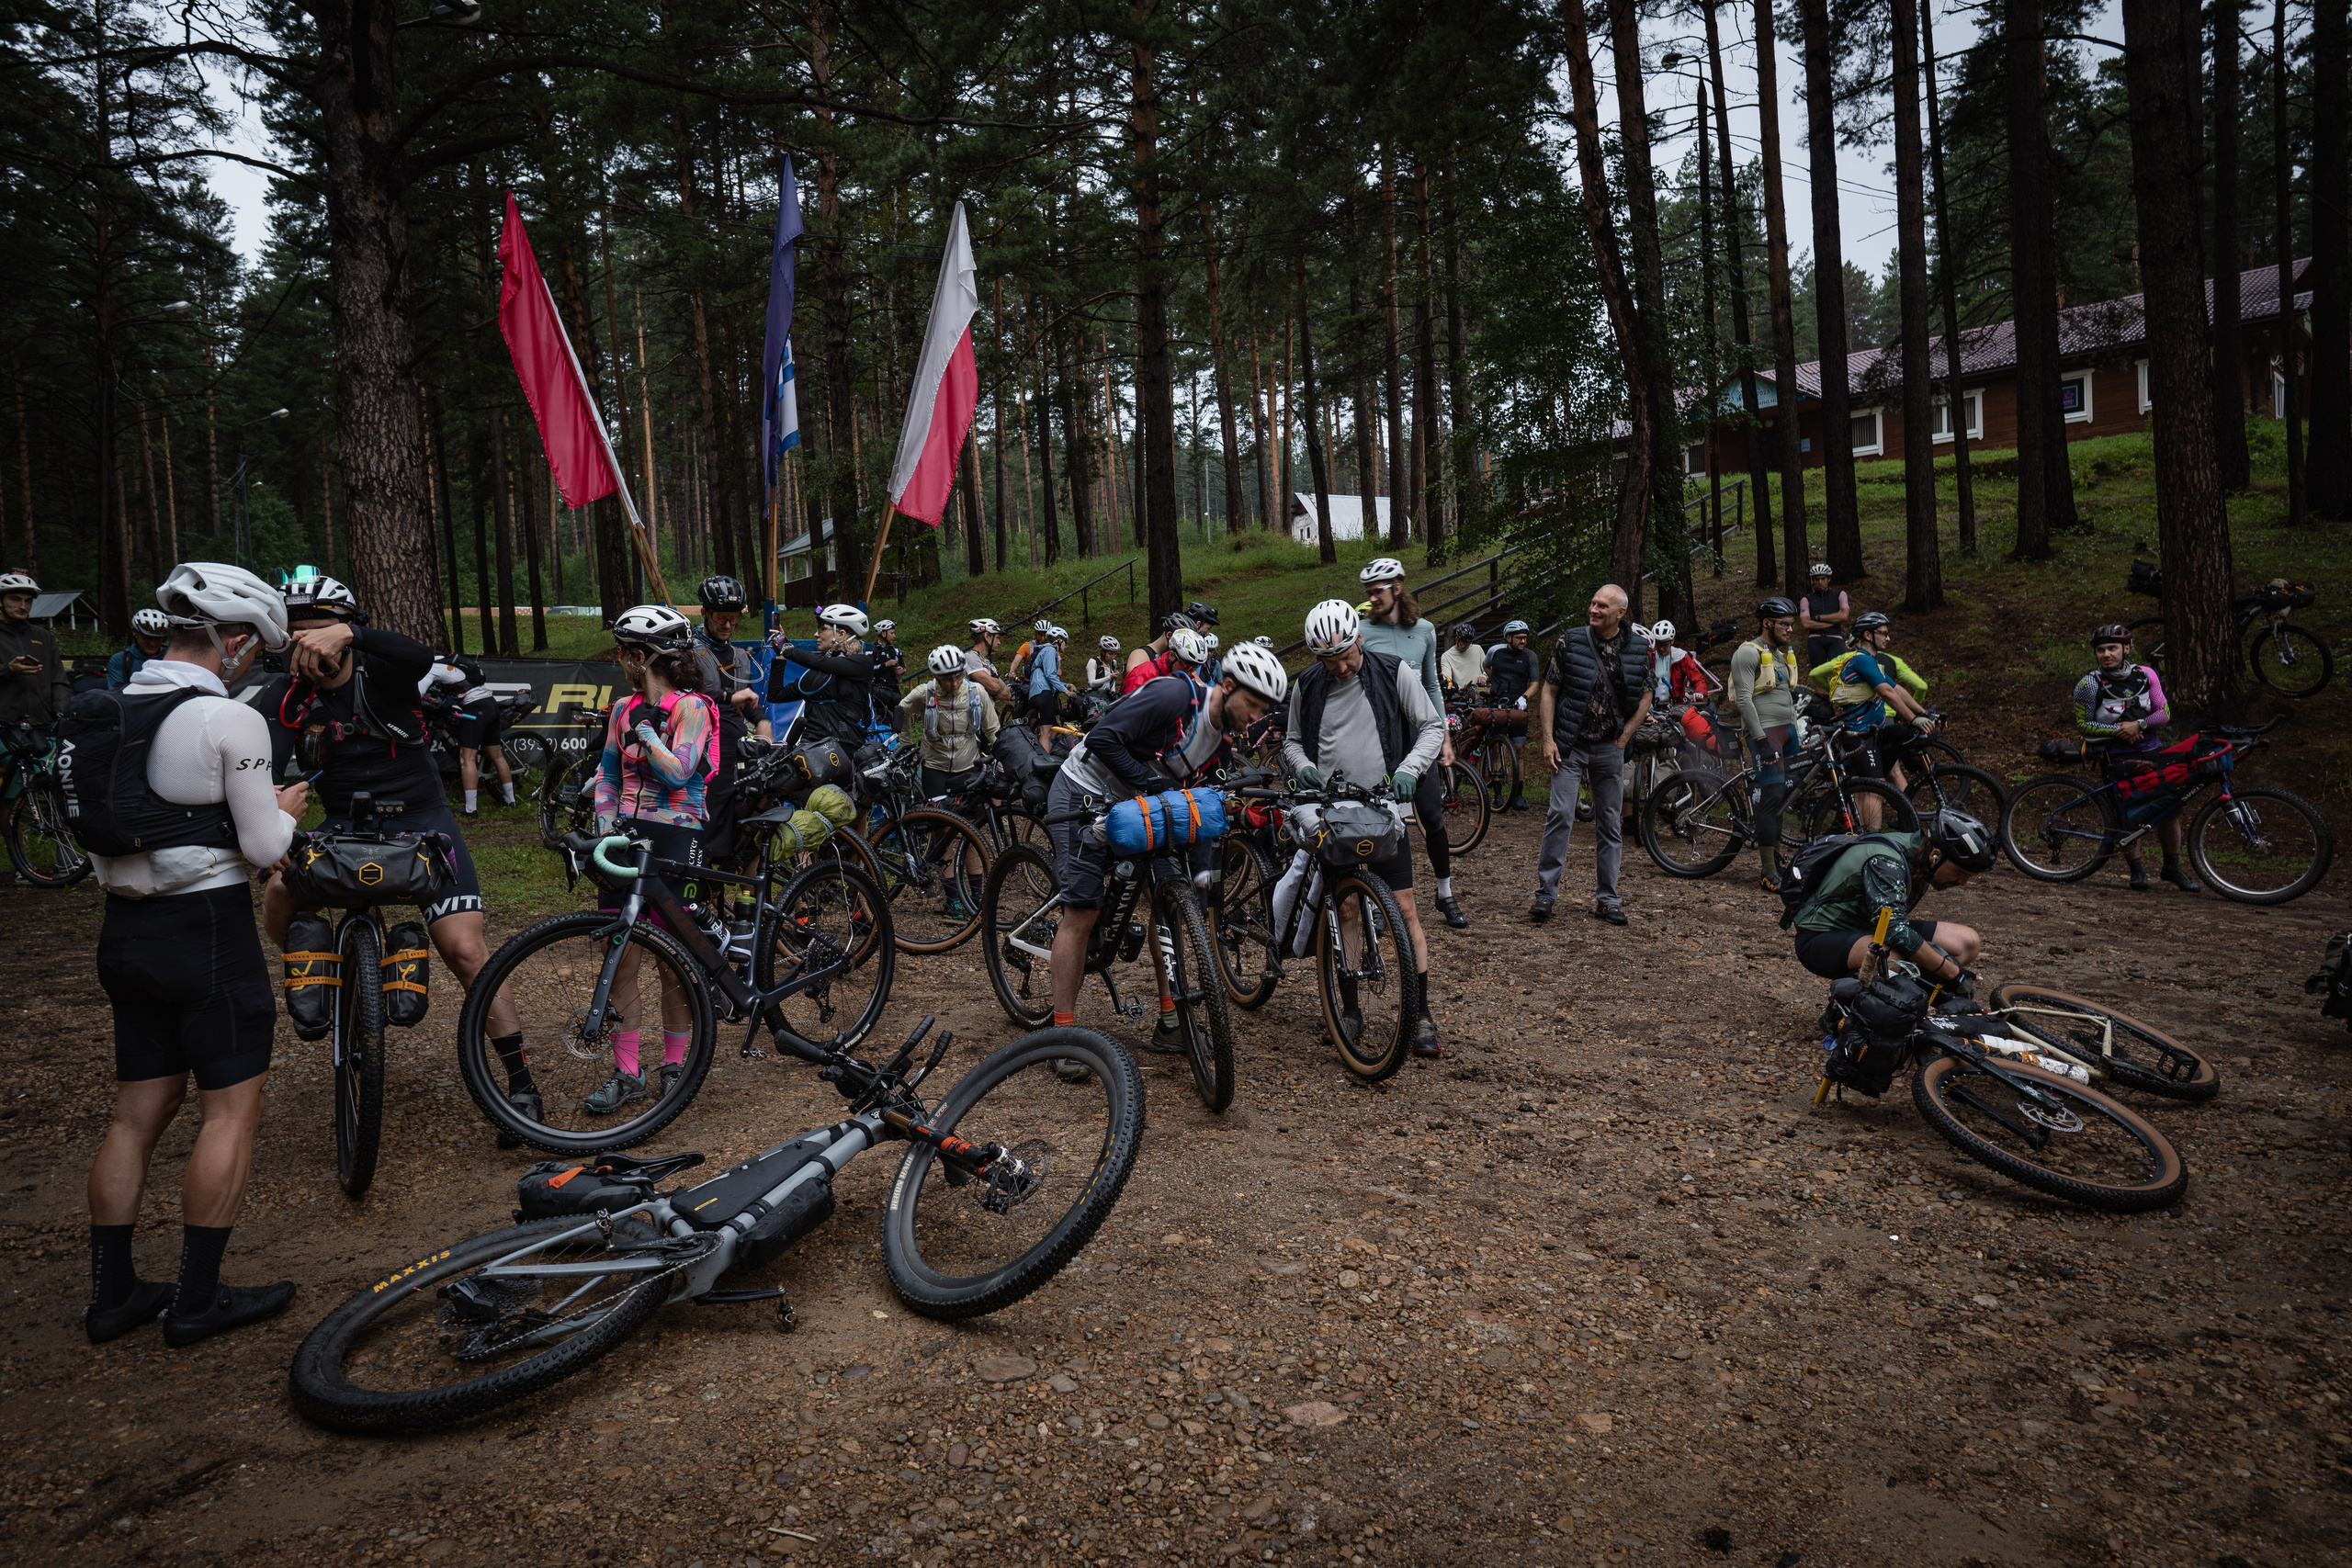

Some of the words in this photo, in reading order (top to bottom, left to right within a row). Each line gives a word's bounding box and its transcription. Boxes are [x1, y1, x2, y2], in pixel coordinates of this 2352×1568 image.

[387, 723, 409, 739] USWE
[560, 738, 587, 750] 600
[373, 1250, 451, 1293] MAXXIS
